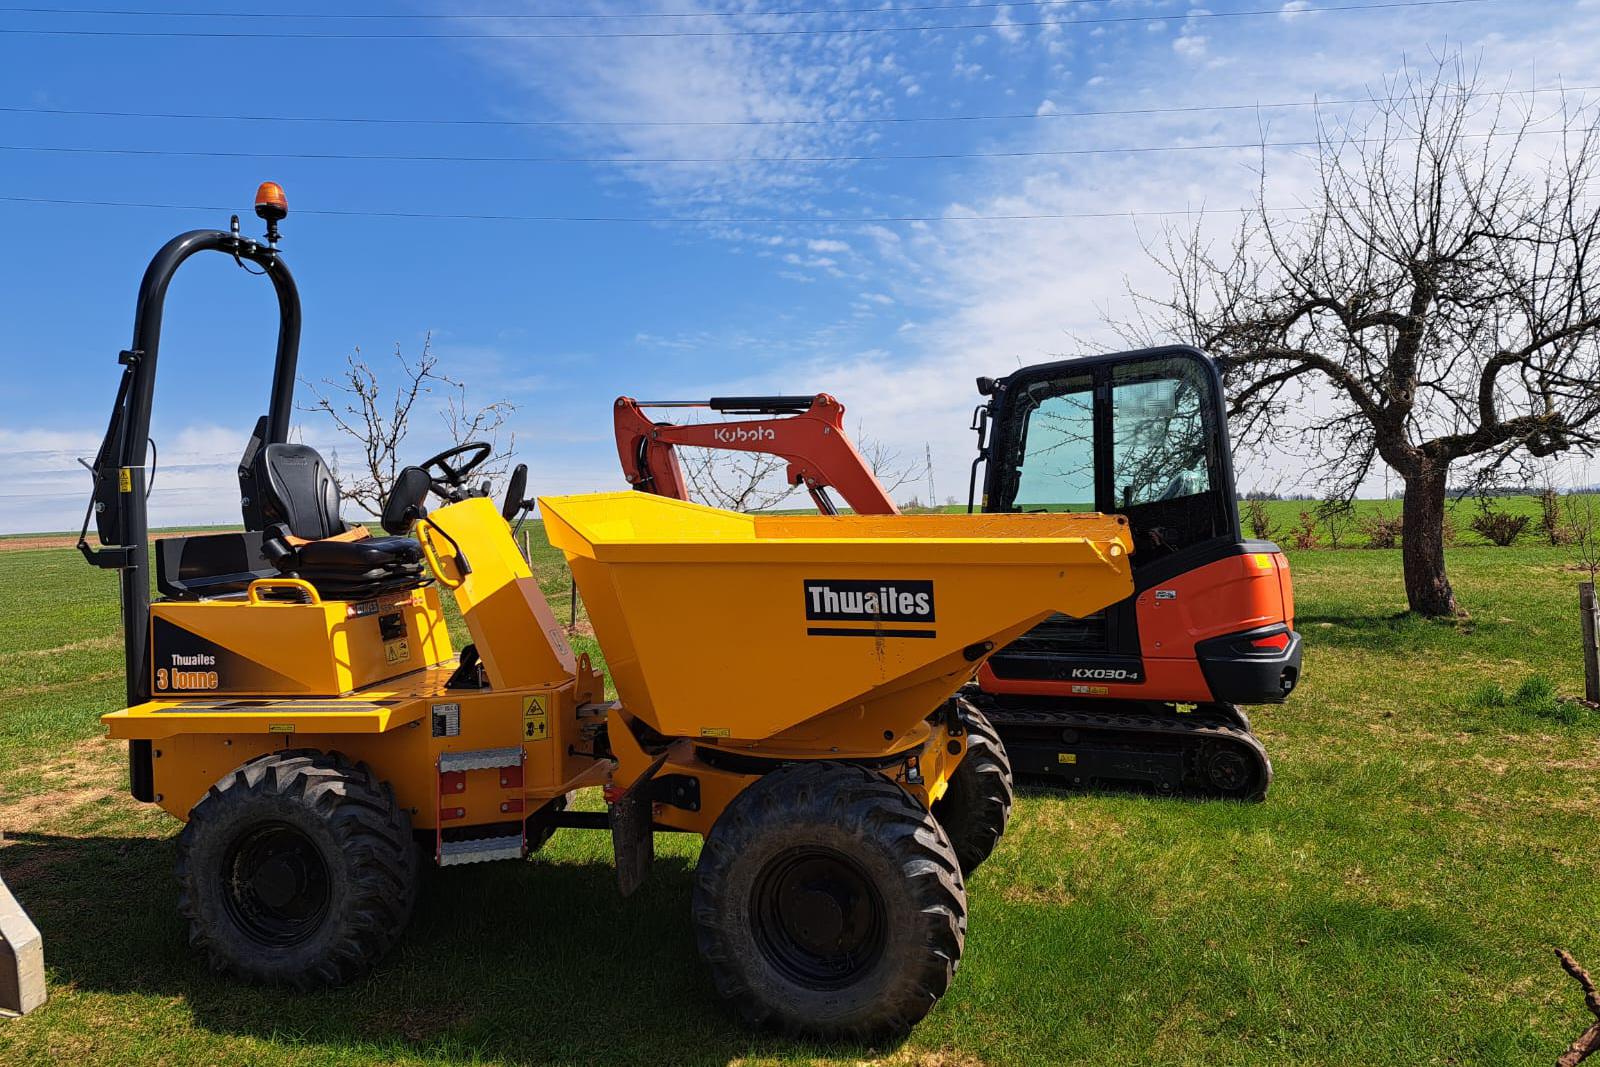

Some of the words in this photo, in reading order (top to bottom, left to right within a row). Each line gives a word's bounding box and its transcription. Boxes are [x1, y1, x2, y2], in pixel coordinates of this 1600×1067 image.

[714, 426, 775, 443] Kubota
[808, 586, 930, 615] Thwaites
[171, 653, 216, 666] Thwaites
[157, 668, 169, 690] 3
[171, 667, 219, 690] tonne
[1071, 668, 1138, 680] KX030-4
